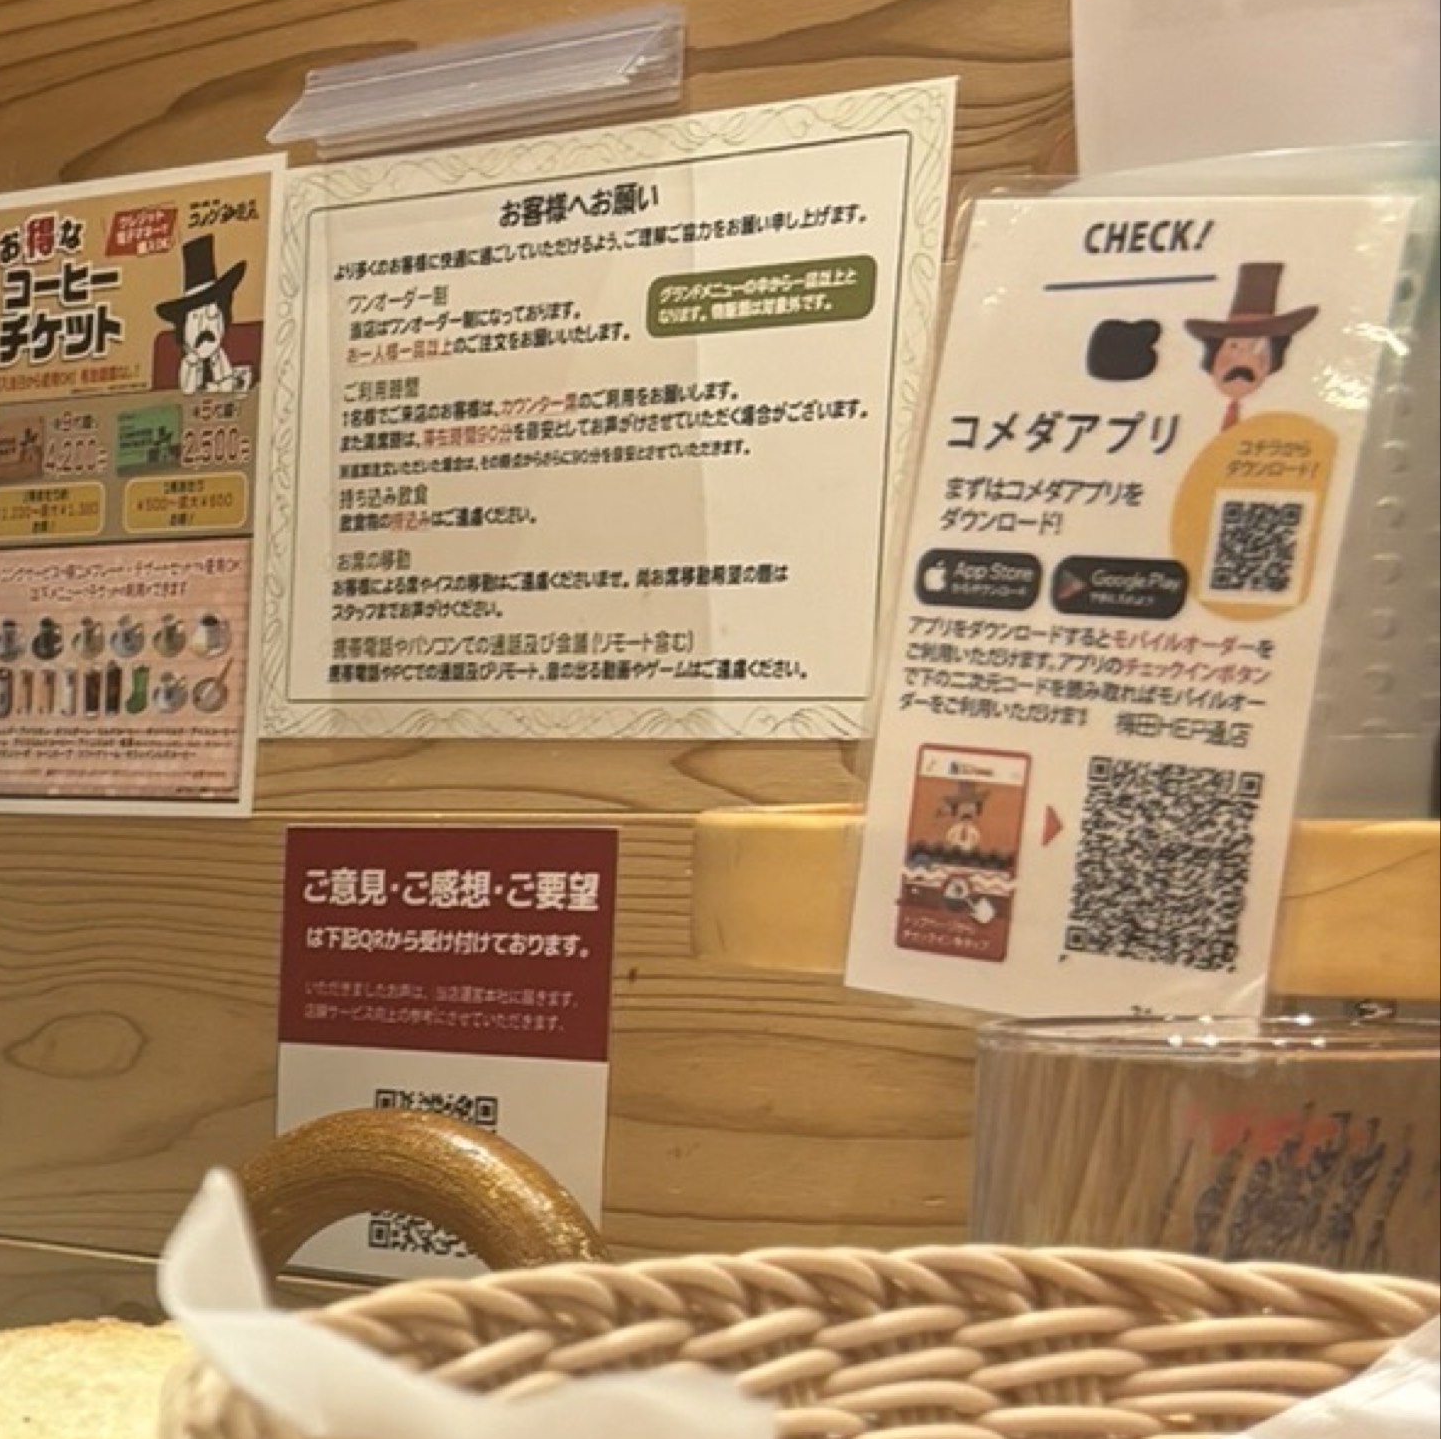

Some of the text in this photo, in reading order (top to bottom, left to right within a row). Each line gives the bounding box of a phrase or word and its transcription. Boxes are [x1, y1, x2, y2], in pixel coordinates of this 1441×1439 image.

[499, 182, 659, 228] お客様へお願い
[1083, 219, 1214, 254] CHECK!
[4, 260, 121, 313] コーヒー
[344, 377, 419, 402] ご利用時間
[947, 411, 1179, 455] コメダアプリ
[339, 484, 428, 509] 持ち込み飲食
[945, 476, 1145, 506] まずはコメダアプリを
[940, 507, 1064, 536] ダウンロード!
[954, 561, 1035, 582] App Store
[1090, 568, 1182, 592] Google Play
[303, 867, 602, 912] ご意見・ご感想・ご要望
[305, 927, 591, 959] は下記QRから受け付けております。
